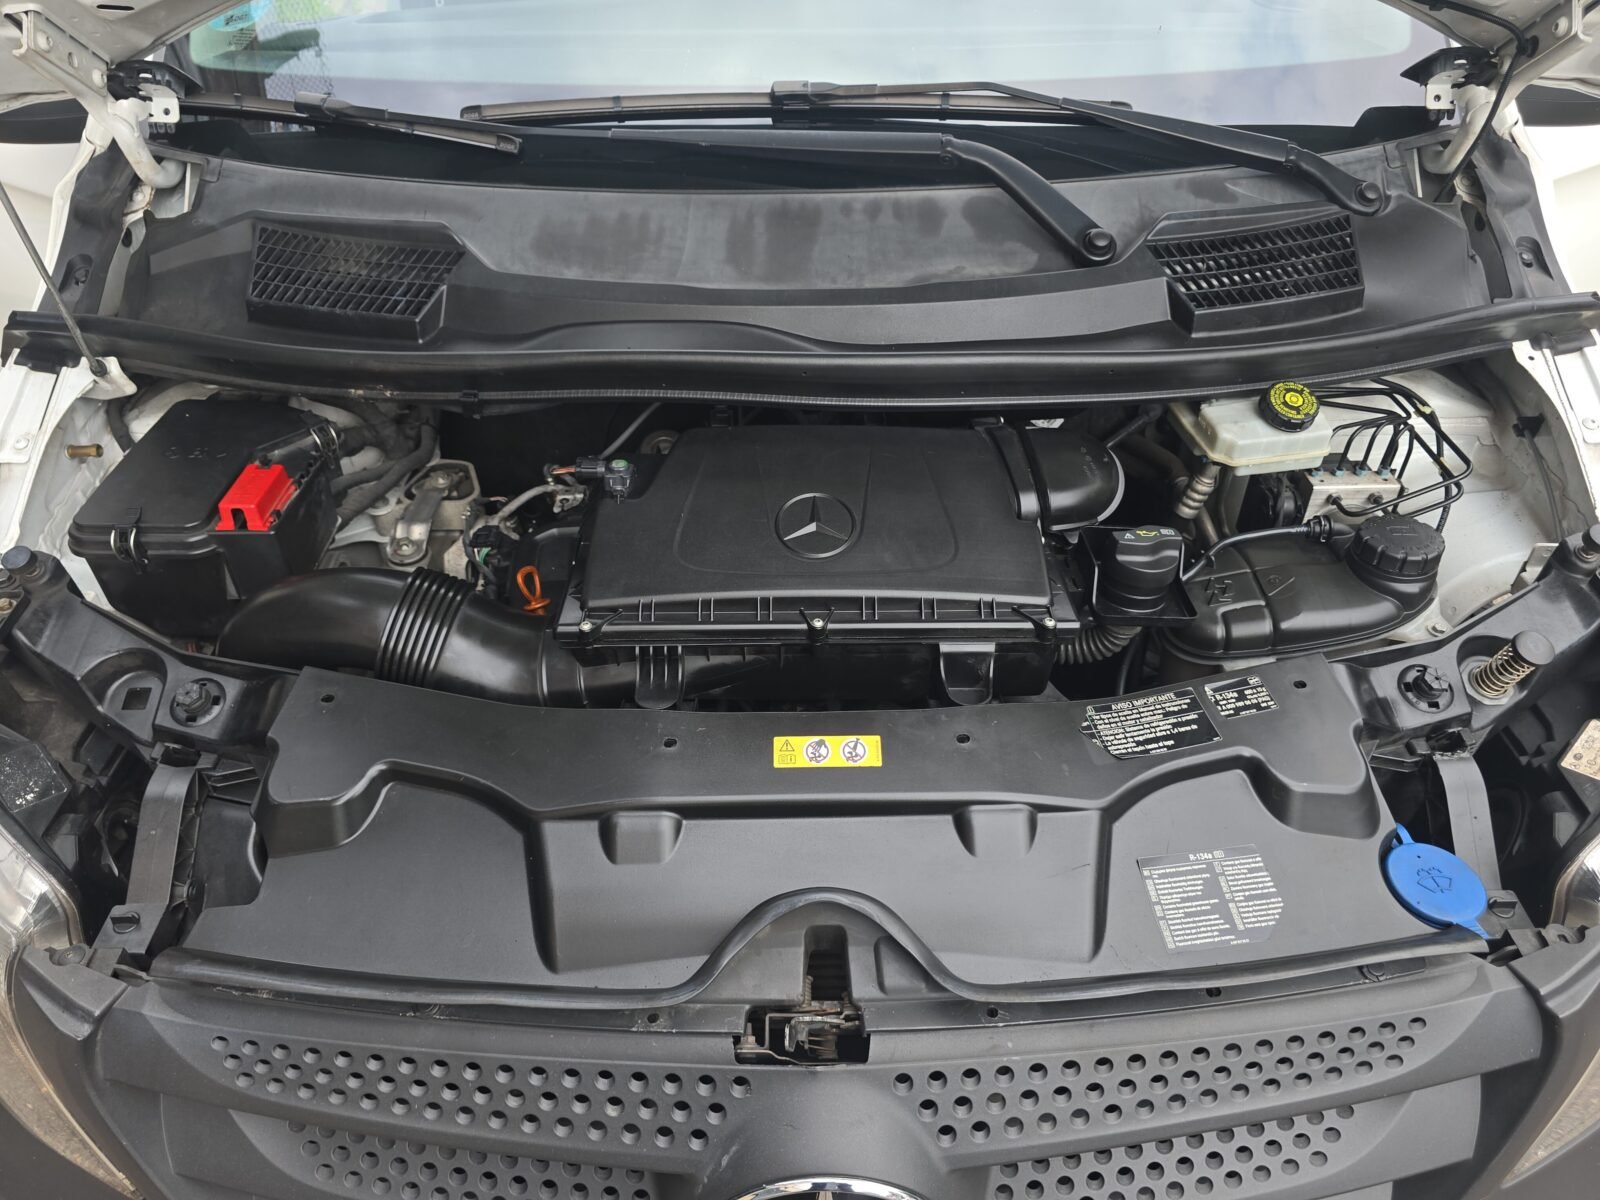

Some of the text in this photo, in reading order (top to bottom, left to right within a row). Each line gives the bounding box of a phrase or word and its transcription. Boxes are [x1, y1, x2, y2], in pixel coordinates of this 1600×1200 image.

[1215, 692, 1238, 700] R-134a
[1111, 693, 1176, 710] AVISO IMPORTANTE
[1189, 853, 1212, 861] R-134a
